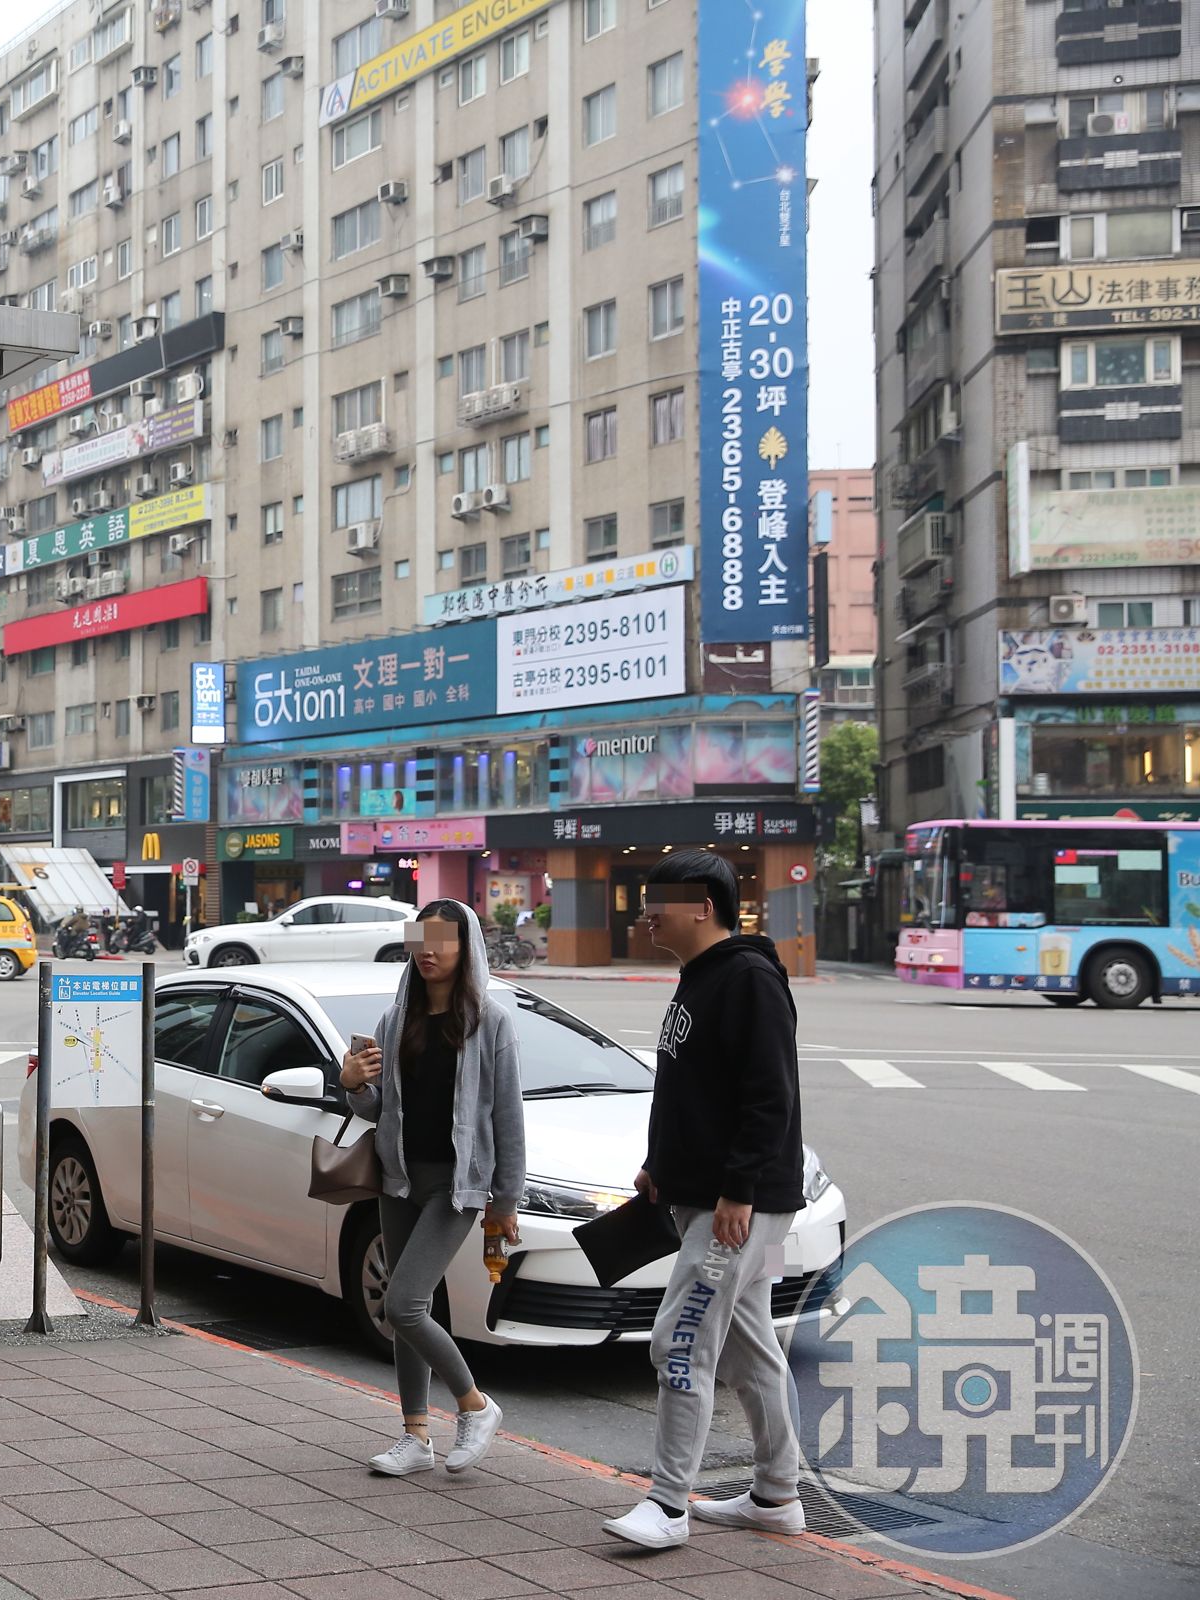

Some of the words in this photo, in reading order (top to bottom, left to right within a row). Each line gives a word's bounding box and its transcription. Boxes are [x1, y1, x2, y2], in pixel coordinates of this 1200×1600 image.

[356, 26, 454, 97] ACTIVATE
[462, 0, 535, 39] ENGL
[721, 296, 743, 382] 中正古亭
[721, 387, 743, 611] 2365-6888
[26, 514, 126, 566] 夏恩英語
[757, 479, 788, 605] 登峰入主
[512, 625, 561, 646] 東門分校
[564, 609, 667, 646] 2395-8101
[294, 665, 320, 678] TAIDAI
[294, 672, 342, 689] ONE-ON-ONE
[353, 646, 470, 690] 文理一對一
[512, 667, 561, 688] 古亭分校
[564, 655, 667, 688] 2395-6101
[353, 698, 375, 715] 高中
[383, 694, 405, 711] 國中
[414, 689, 437, 708] 國小
[446, 683, 470, 703] 全科
[597, 734, 656, 757] mentor
[240, 767, 283, 788] 曼都髮型
[581, 825, 601, 833] SUSHI
[763, 819, 797, 829] SUSHI
[245, 832, 281, 849] JASONS
[32, 866, 49, 881] 6
[73, 981, 138, 991] 本站電梯位置圖
[657, 1001, 693, 1059] AP
[667, 1281, 716, 1390] ATHLETICS
